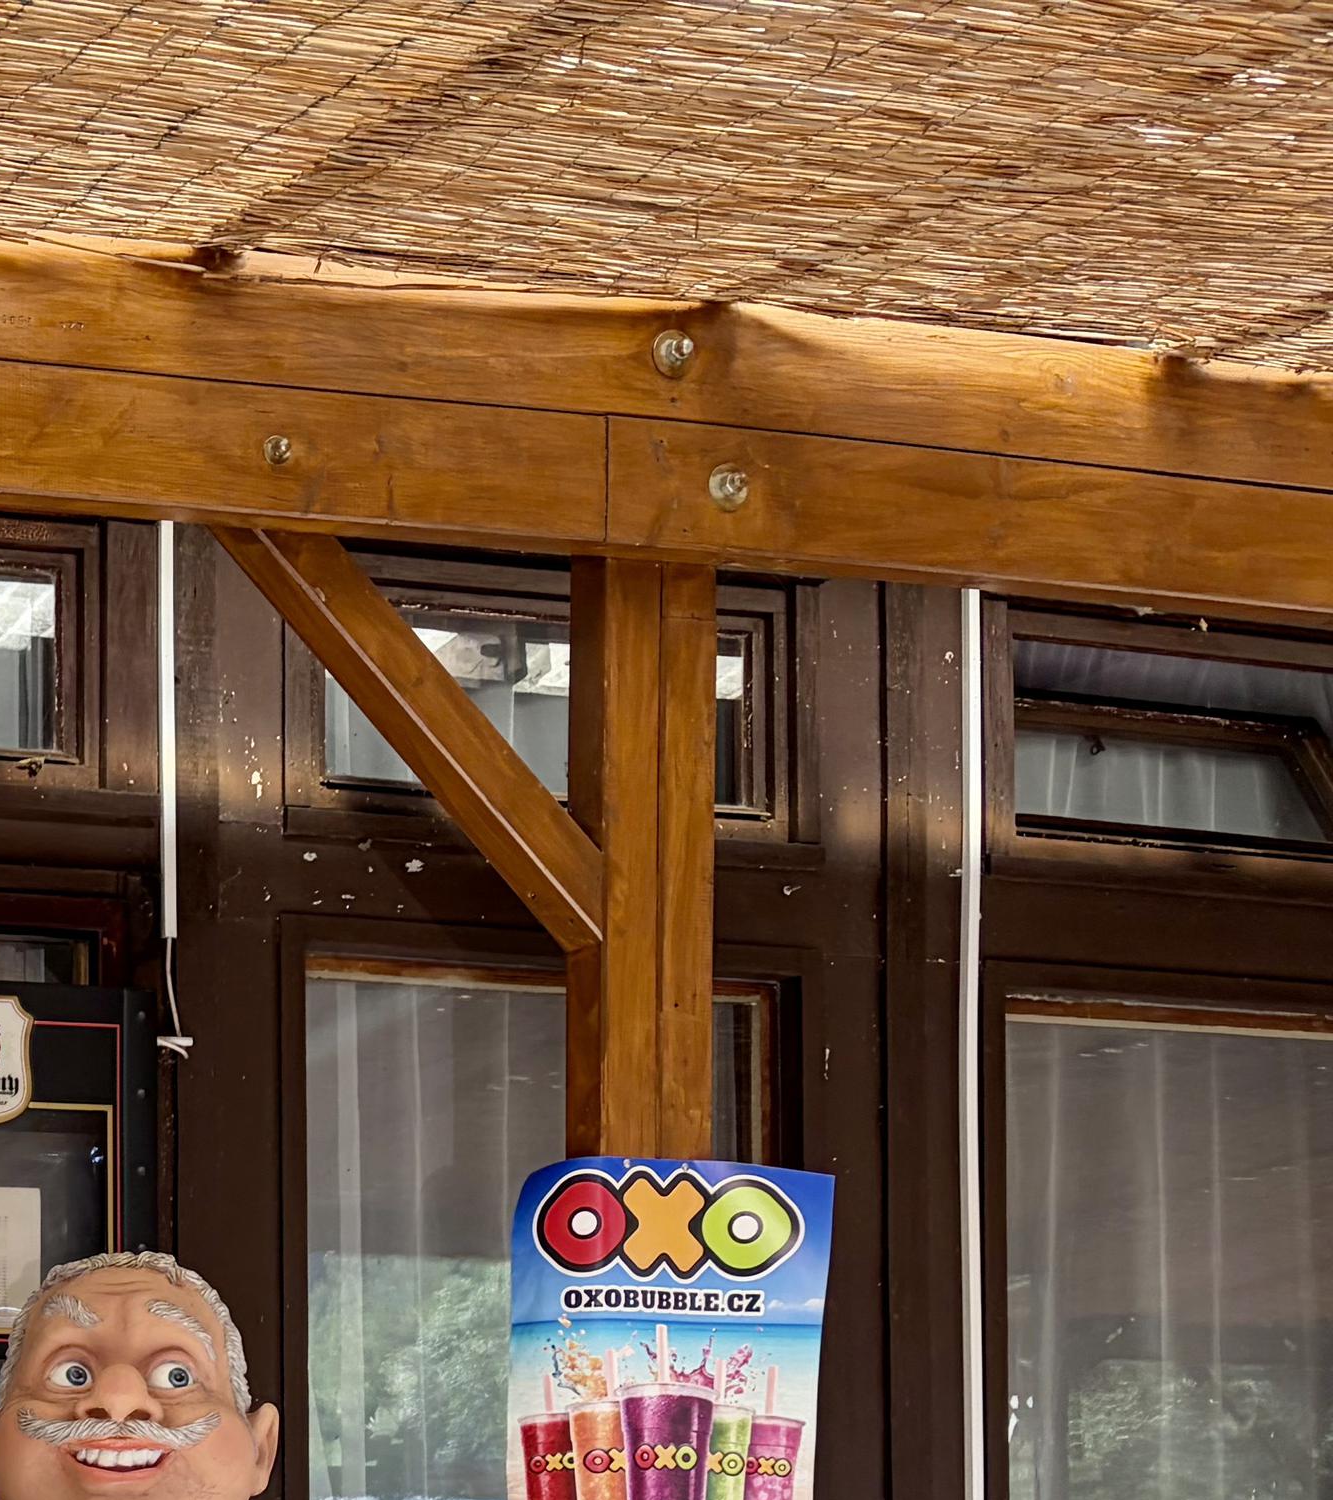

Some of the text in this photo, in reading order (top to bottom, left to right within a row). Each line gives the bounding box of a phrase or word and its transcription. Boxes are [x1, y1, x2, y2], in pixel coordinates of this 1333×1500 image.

[536, 1168, 802, 1281] OXO
[563, 1287, 763, 1313] OXOBUBBLE.CZ
[584, 1449, 625, 1473] OX
[634, 1444, 697, 1471] OXO
[708, 1452, 744, 1476] XO
